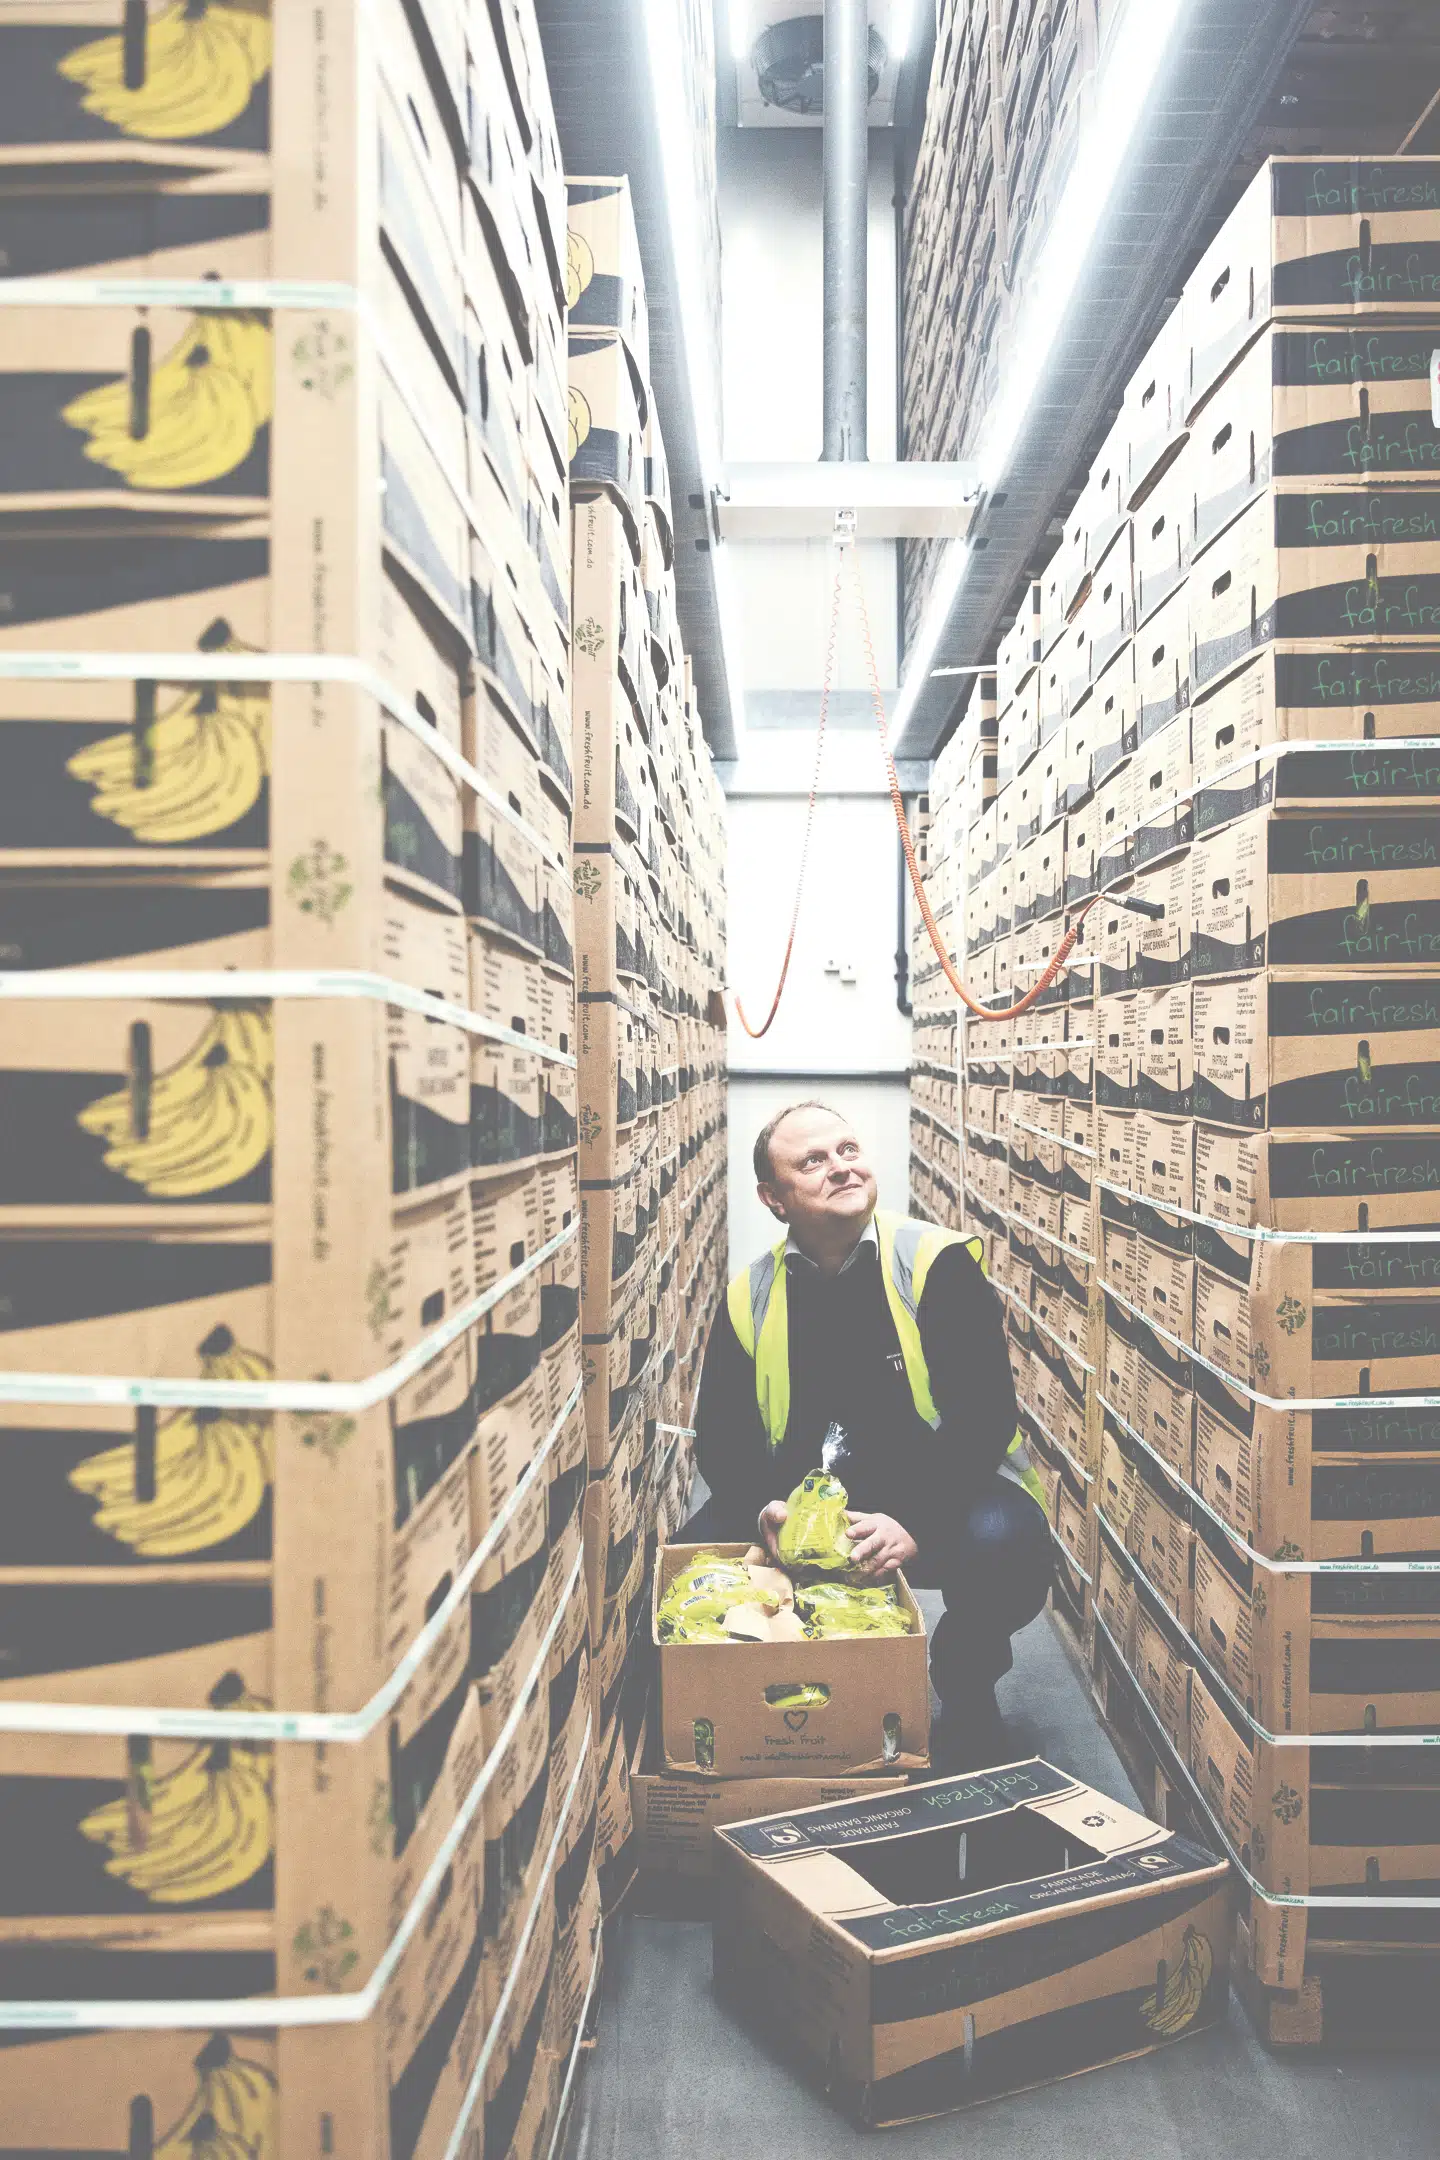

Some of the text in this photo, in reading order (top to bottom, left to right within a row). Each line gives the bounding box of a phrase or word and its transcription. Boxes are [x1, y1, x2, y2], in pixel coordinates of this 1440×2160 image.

[1306, 167, 1438, 208] fairfresh
[1340, 253, 1440, 298] fairfre
[1343, 422, 1440, 467] fairfre
[586, 505, 596, 569] shfruit.com.do
[1305, 498, 1436, 540] fairfresh
[1340, 585, 1440, 629] farfre
[1312, 659, 1440, 700] fairfresh
[583, 710, 593, 810] www.freshfruit.com.do
[1344, 750, 1440, 790] fairfr
[581, 858, 592, 880] Fresh
[1337, 912, 1440, 957] fairfre
[582, 954, 591, 1055] www.fresruit.com.do
[1305, 985, 1439, 1028] fairfresh
[1340, 1074, 1440, 1119] fairfre
[1308, 1147, 1440, 1189] fairfresh
[1255, 1241, 1265, 1292] ruit.com.do
[1343, 1242, 1440, 1280] fairfre
[1285, 1386, 1296, 1486] www.freshfruit.co.do
[1282, 1630, 1292, 1730] www.freshfruit.com.do
[923, 1773, 1039, 1808] fairfresh
[807, 1807, 912, 1833] ORGANIC BANANAS
[839, 1821, 900, 1838] FAIRTRADE
[1029, 1870, 1136, 1901] ORGANIC BANANAS
[1040, 1870, 1104, 1890] FAIRTRADE
[883, 1901, 1019, 1936] fairfresh
[1277, 1876, 1291, 1983] www.freshfruit..do
